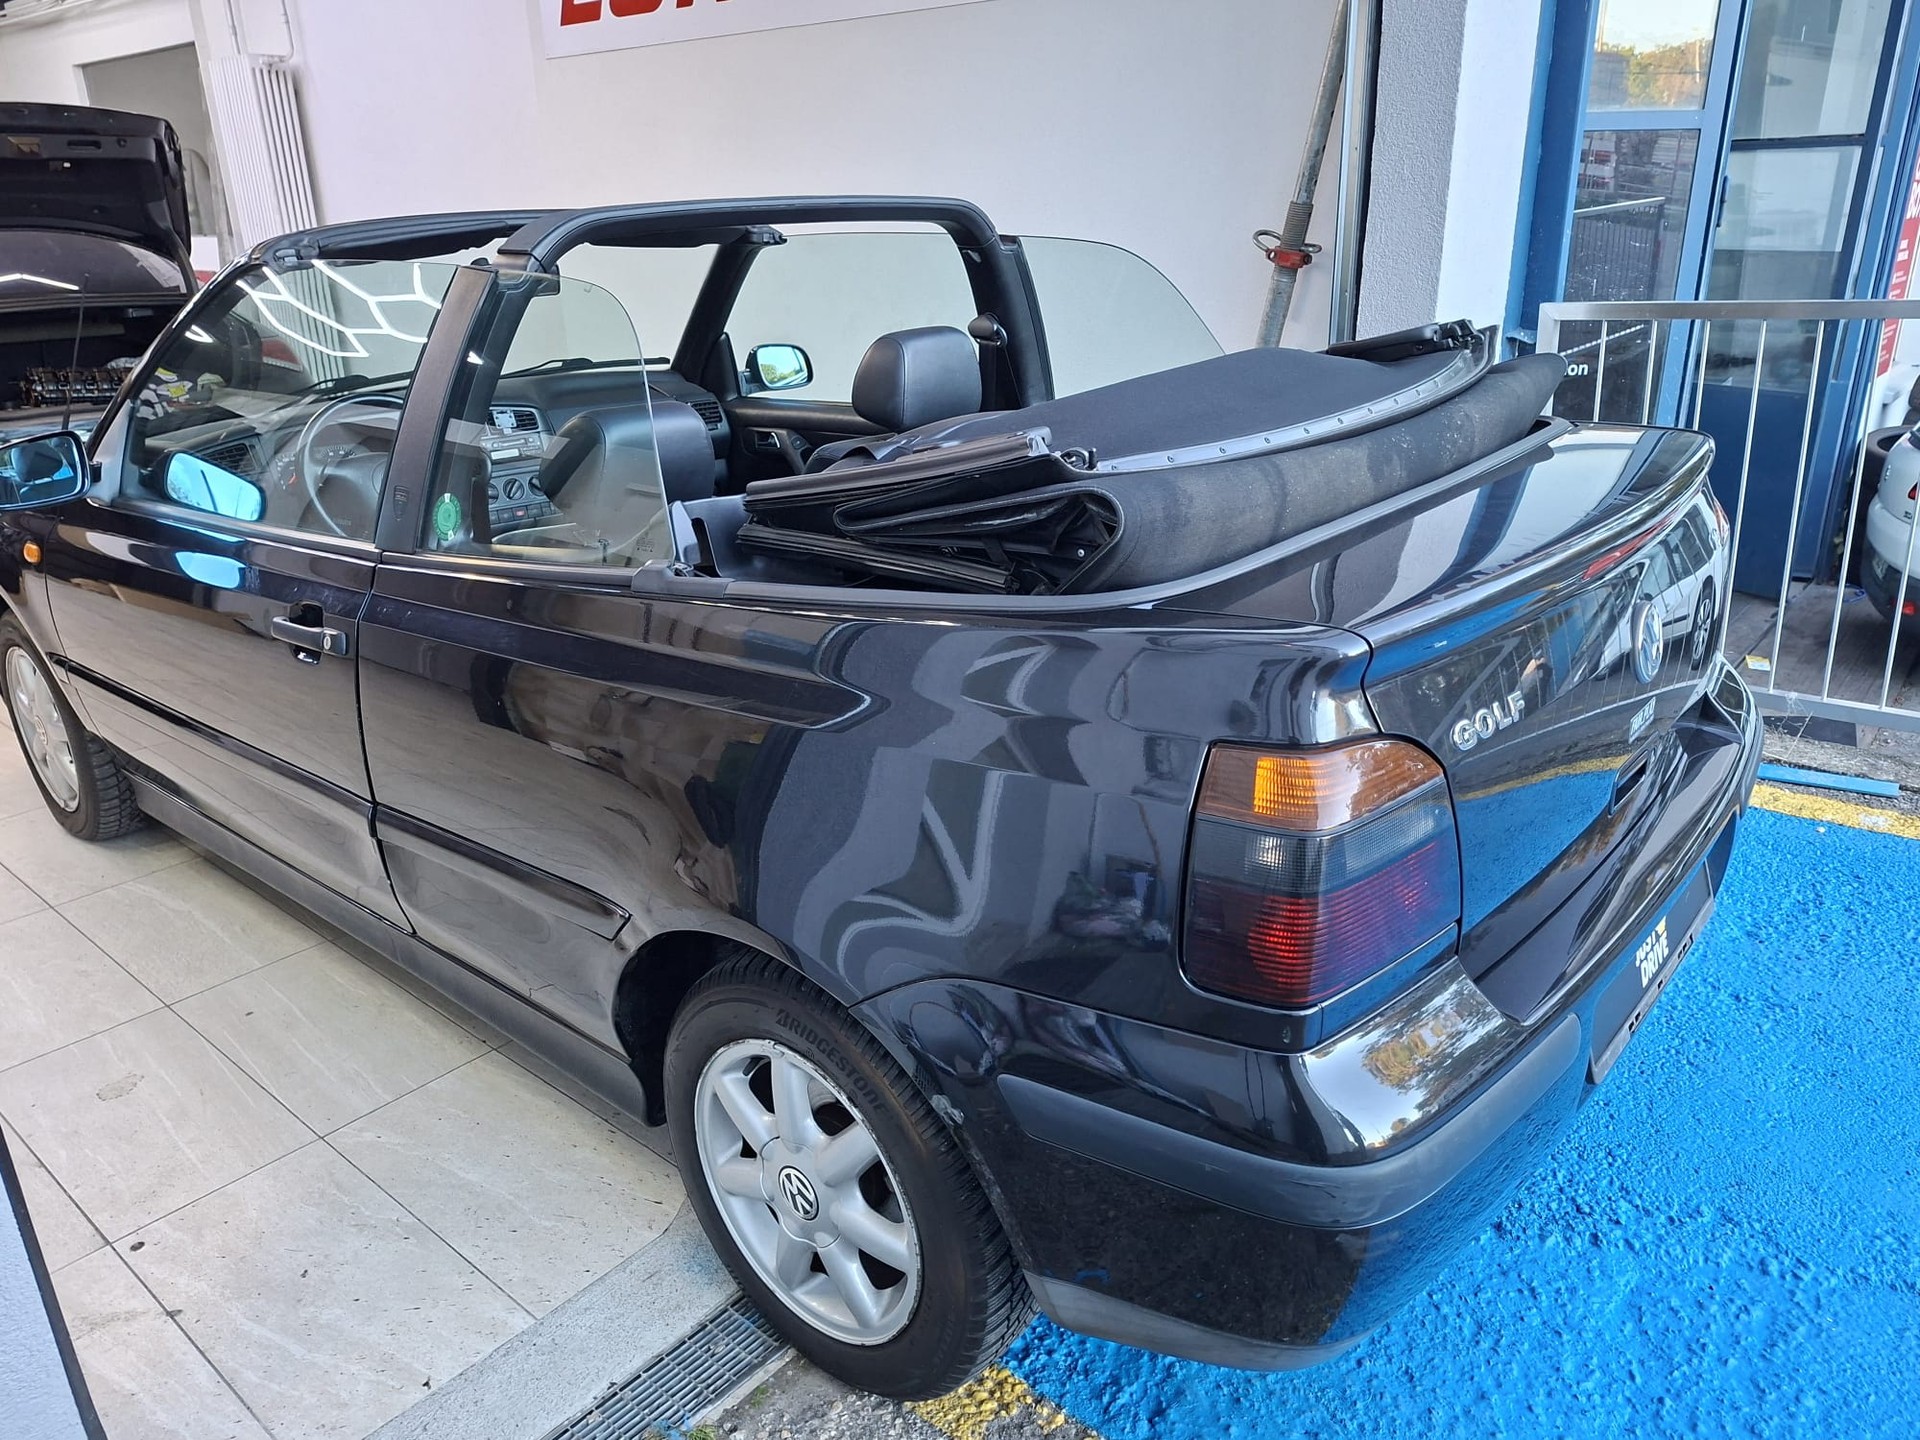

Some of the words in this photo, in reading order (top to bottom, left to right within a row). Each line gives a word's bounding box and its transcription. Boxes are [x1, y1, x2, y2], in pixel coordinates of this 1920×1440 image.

[1451, 690, 1525, 751] GOLF
[1640, 929, 1669, 988] DRIVE
[775, 1007, 889, 1116] BRIDGESTONE
